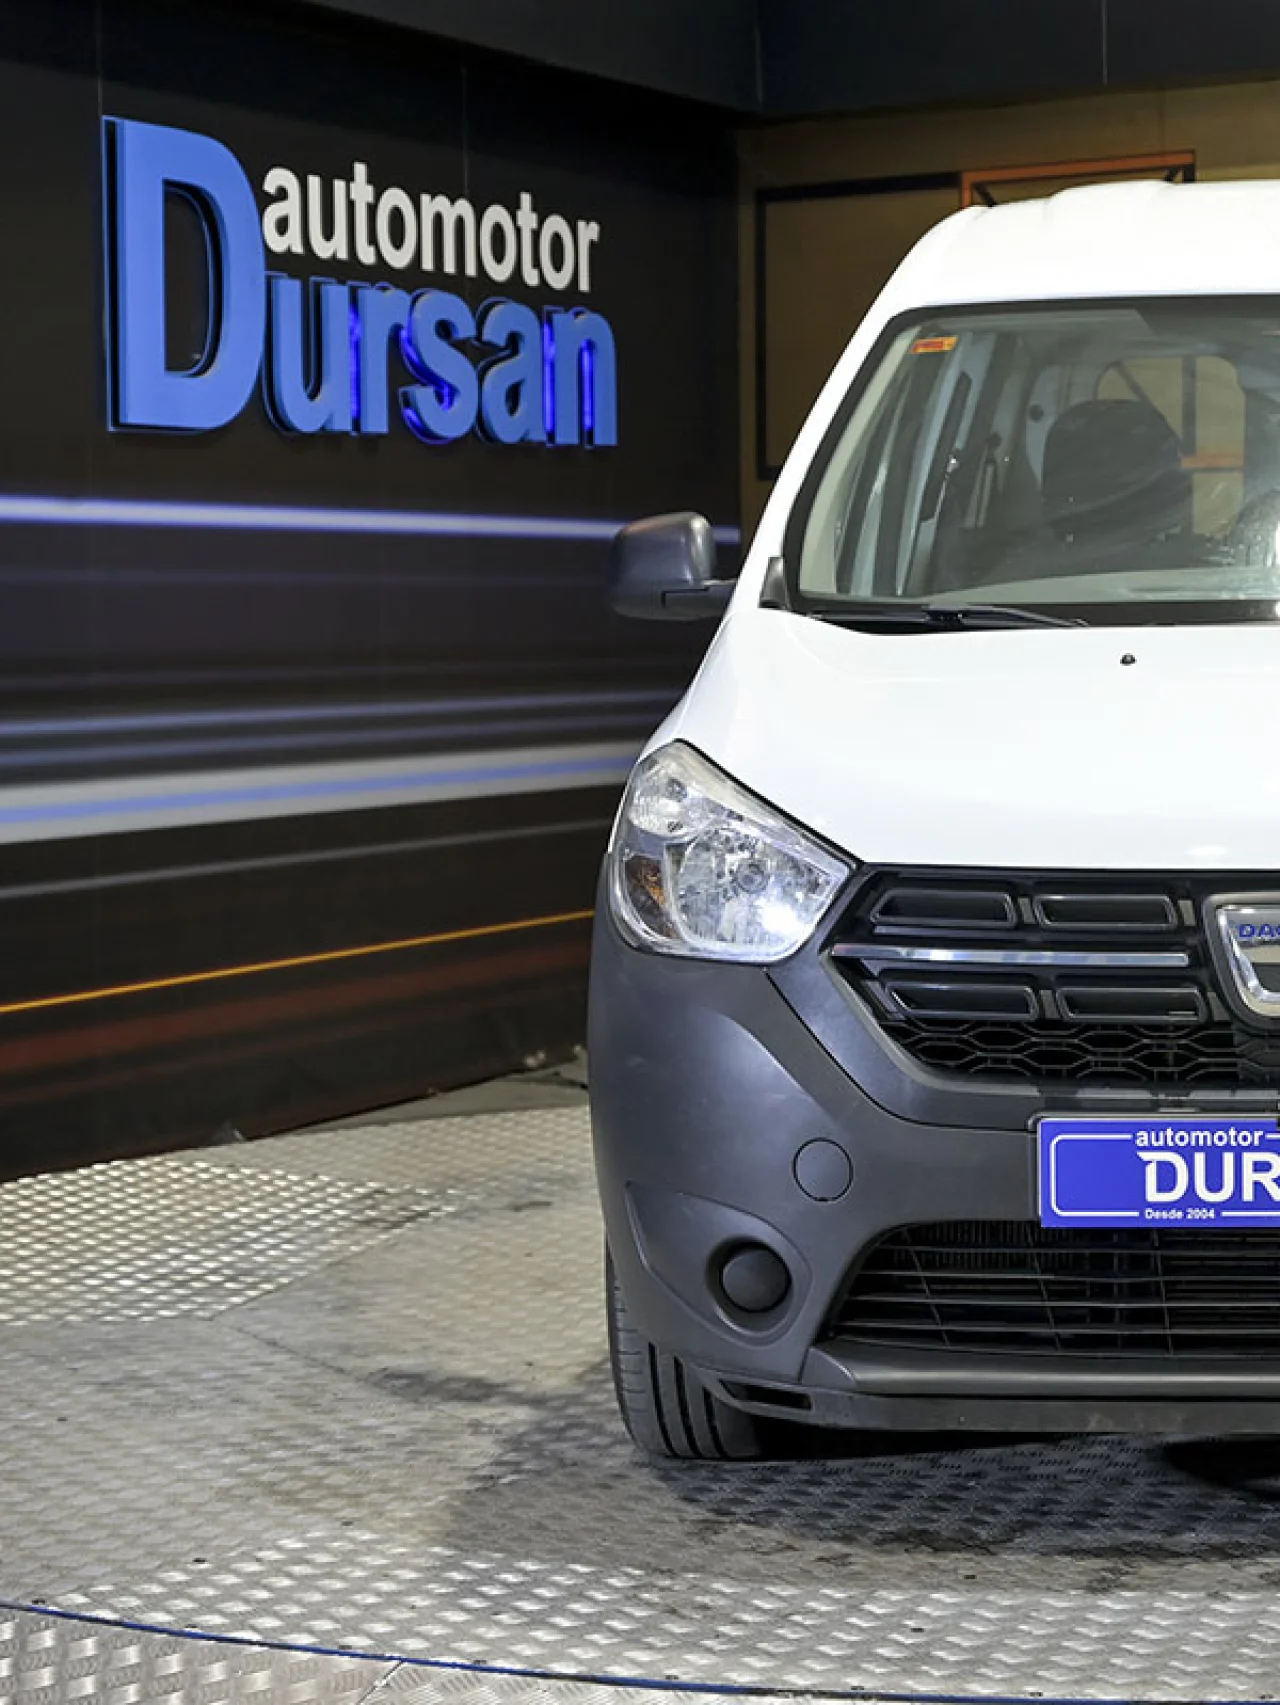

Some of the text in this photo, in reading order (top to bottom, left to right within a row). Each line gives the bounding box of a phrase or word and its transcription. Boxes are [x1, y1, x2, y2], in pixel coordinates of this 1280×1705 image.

[262, 162, 600, 292] automotor
[102, 115, 617, 446] Dursan
[1136, 1127, 1264, 1147] automotor
[1145, 1207, 1215, 1219] Desde 2004
